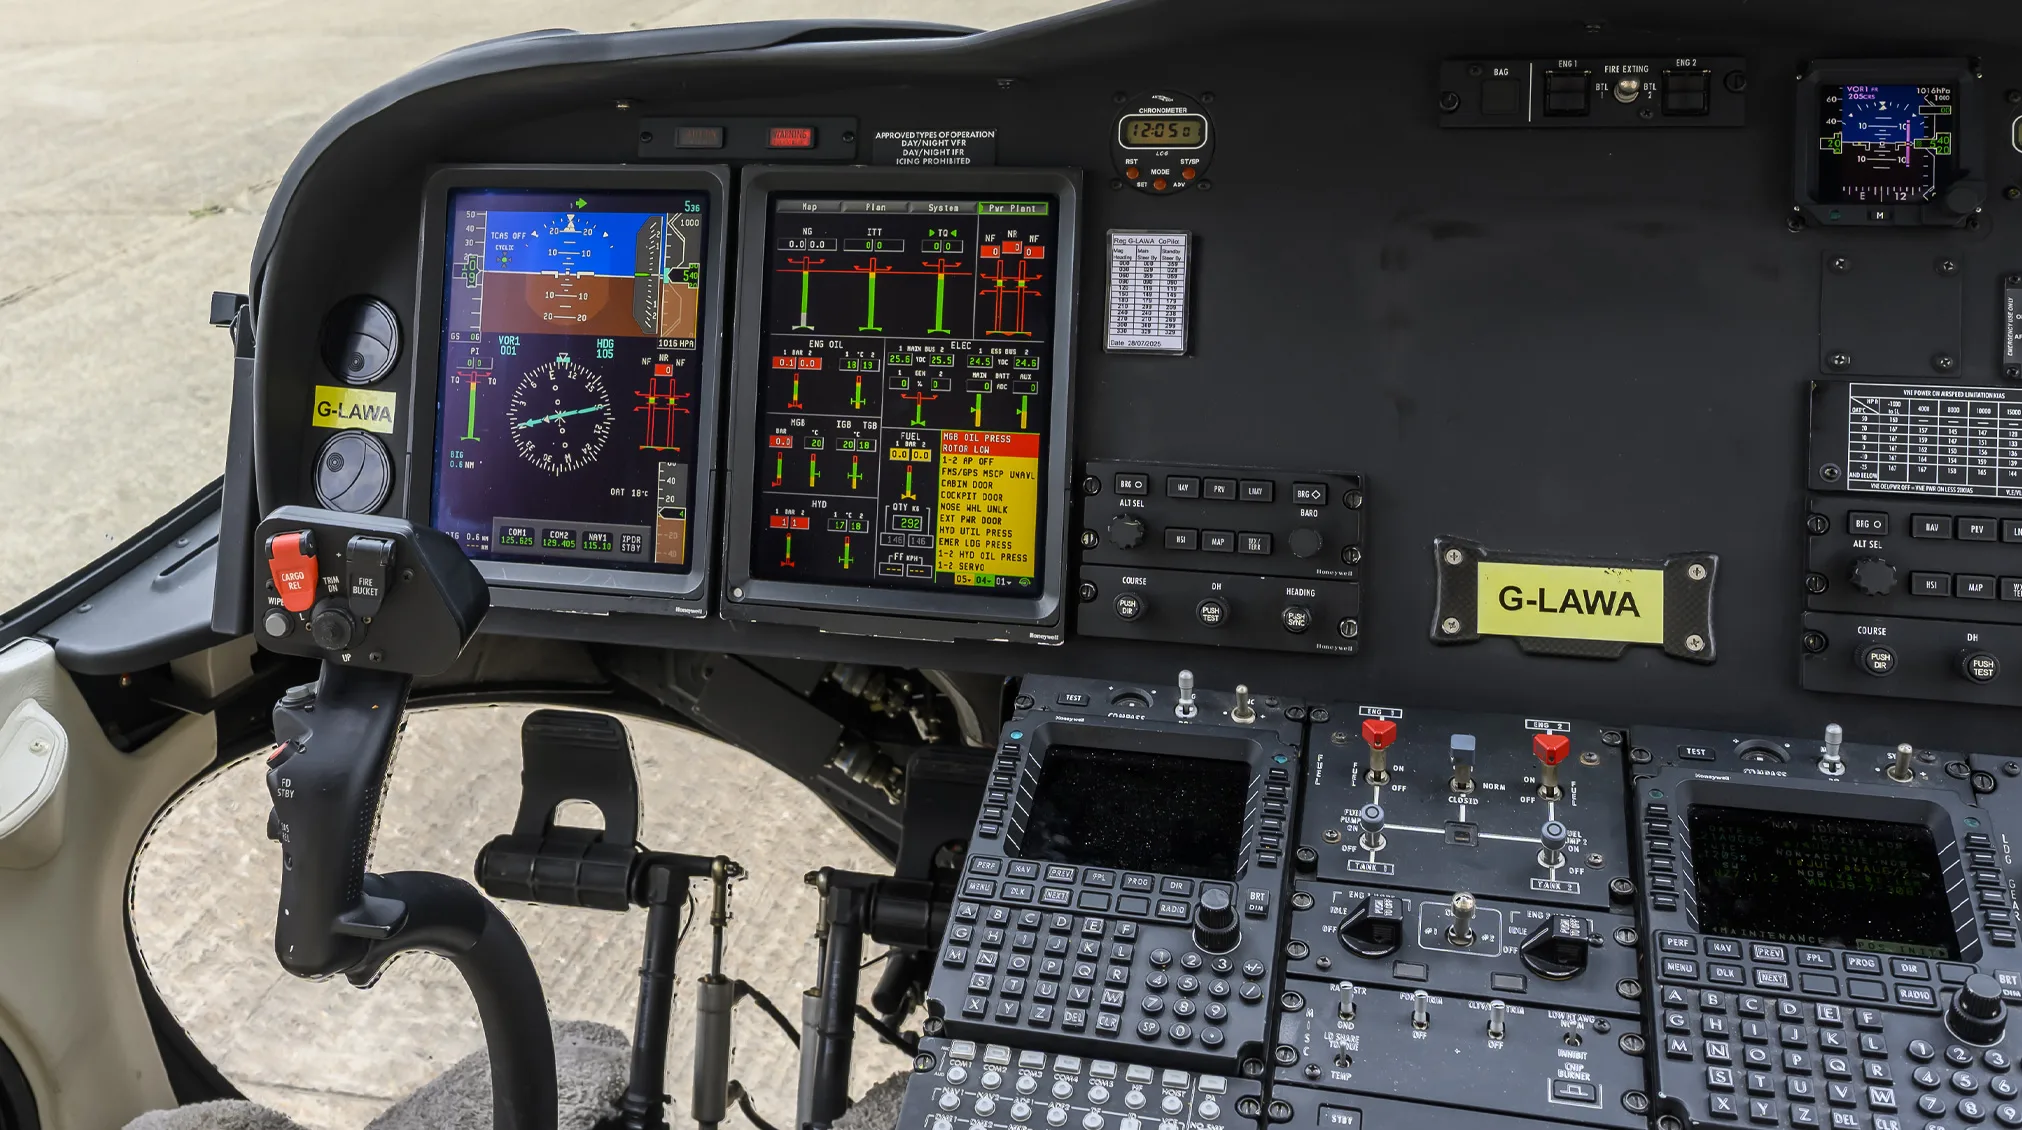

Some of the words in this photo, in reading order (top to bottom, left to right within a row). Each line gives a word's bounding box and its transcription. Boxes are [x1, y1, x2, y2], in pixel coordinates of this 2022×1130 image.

[1558, 60, 1572, 68] ENG
[1676, 58, 1690, 67] ENG
[1691, 58, 1697, 66] 2
[1493, 68, 1509, 76] BAG
[1605, 65, 1620, 73] FIRE
[1622, 65, 1649, 73] EXTING
[1595, 83, 1608, 91] BTL
[1643, 83, 1657, 91] BTL
[1916, 87, 1950, 95] 1016hPa
[903, 149, 950, 157] DAY/NIGHT
[802, 202, 817, 212] Map
[866, 203, 886, 211] Plan
[928, 203, 959, 213] System
[989, 204, 1006, 213] Pwr
[1011, 205, 1036, 213] Plant
[466, 210, 475, 218] 50
[681, 219, 700, 227] 1000
[491, 231, 510, 240] TCAS
[512, 232, 527, 240] OFF
[802, 228, 812, 236] NG
[867, 228, 882, 236] ITT
[451, 332, 460, 341] GS
[498, 335, 520, 345] VOR1
[596, 339, 614, 349] HDG
[658, 339, 677, 348] 1016
[679, 340, 694, 348] HPA
[809, 340, 824, 348] ENG
[829, 340, 843, 349] OIL
[951, 341, 972, 350] ELEC
[470, 347, 480, 355] PI
[596, 349, 614, 359] 105
[317, 401, 393, 423] G-LAWA
[837, 420, 851, 428] IGB
[863, 422, 877, 430] TGB
[901, 432, 920, 440] FUEL
[964, 434, 979, 442] OIL
[985, 434, 1011, 443] PRESS
[943, 444, 968, 452] ROTOR
[942, 468, 978, 477] FMS/GPS
[1010, 471, 1035, 480] UNAVL
[941, 480, 967, 488] CABIN
[973, 481, 993, 489] DOOR
[941, 491, 976, 500] COCKPIT
[983, 493, 1003, 501] DOOR
[1298, 490, 1310, 499] BRG
[812, 500, 827, 508] HYD
[893, 503, 908, 512] QTY
[1119, 499, 1131, 507] ALT
[1132, 499, 1144, 508] SEL
[940, 503, 960, 511] NOSE
[967, 504, 982, 512] WHL
[987, 505, 1008, 514] UNLK
[1300, 509, 1318, 518] BARO
[901, 518, 920, 529] 292
[940, 514, 955, 523] EXT
[961, 515, 976, 524] PWR
[982, 516, 1002, 525] DOOR
[508, 527, 527, 537] COM1
[550, 530, 569, 539] COM2
[940, 526, 954, 534] HYD
[960, 528, 980, 536] UTIL
[986, 529, 1012, 537] PRESS
[622, 535, 642, 544] XPDR
[939, 538, 959, 546] EMER
[986, 541, 1012, 549] PRESS
[1212, 537, 1224, 546] MAP
[621, 543, 641, 552] STBY
[1853, 540, 1866, 548] ALT
[1869, 541, 1882, 549] SEL
[939, 550, 953, 558] 1-2
[960, 551, 974, 559] HYD
[980, 552, 995, 560] OIL
[1001, 553, 1028, 562] PRESS
[959, 563, 985, 571] SERVO
[281, 571, 304, 581] CARGO
[1316, 568, 1353, 577] Honeywell
[358, 577, 373, 587] FIRE
[1122, 576, 1147, 585] COURSE
[1926, 581, 1937, 589] HSI
[288, 581, 302, 590] REL
[1969, 584, 1983, 592] MAP
[353, 586, 378, 596] BUCKET
[1286, 588, 1316, 597] HEADING
[1119, 600, 1136, 608] PUSH
[1499, 585, 1641, 618] G-LAWA
[1122, 607, 1133, 615] DIR
[1203, 607, 1220, 615] PUSH
[1203, 614, 1219, 622] TEST
[1857, 626, 1887, 636] COURSE
[1967, 634, 1978, 642] DH
[1871, 653, 1890, 661] PUSH
[1874, 661, 1886, 669] DIR
[1974, 668, 1993, 676] TEST
[1066, 694, 1082, 702] TEST
[1686, 747, 1706, 757] TEST
[281, 778, 291, 788] FD
[1483, 782, 1506, 791] NORM
[1392, 784, 1407, 792] OFF
[277, 788, 294, 798] STBY
[1520, 796, 1535, 804] OFF
[1250, 891, 1265, 901] BRT
[1160, 904, 1185, 914] RADIO
[1667, 938, 1689, 948] PERF
[1667, 962, 1693, 973] MENU
[1999, 974, 2018, 986] BRT
[1900, 989, 1930, 1000] RADIO
[1065, 1012, 1083, 1022] DEL
[1098, 1017, 1117, 1027] CLR
[1337, 1021, 1355, 1030] GND
[1488, 1040, 1504, 1049] OFF
[949, 1059, 972, 1068] COM1
[983, 1064, 1008, 1072] COM2
[1330, 1071, 1352, 1081] TEMP
[1557, 1070, 1590, 1081] BURNER
